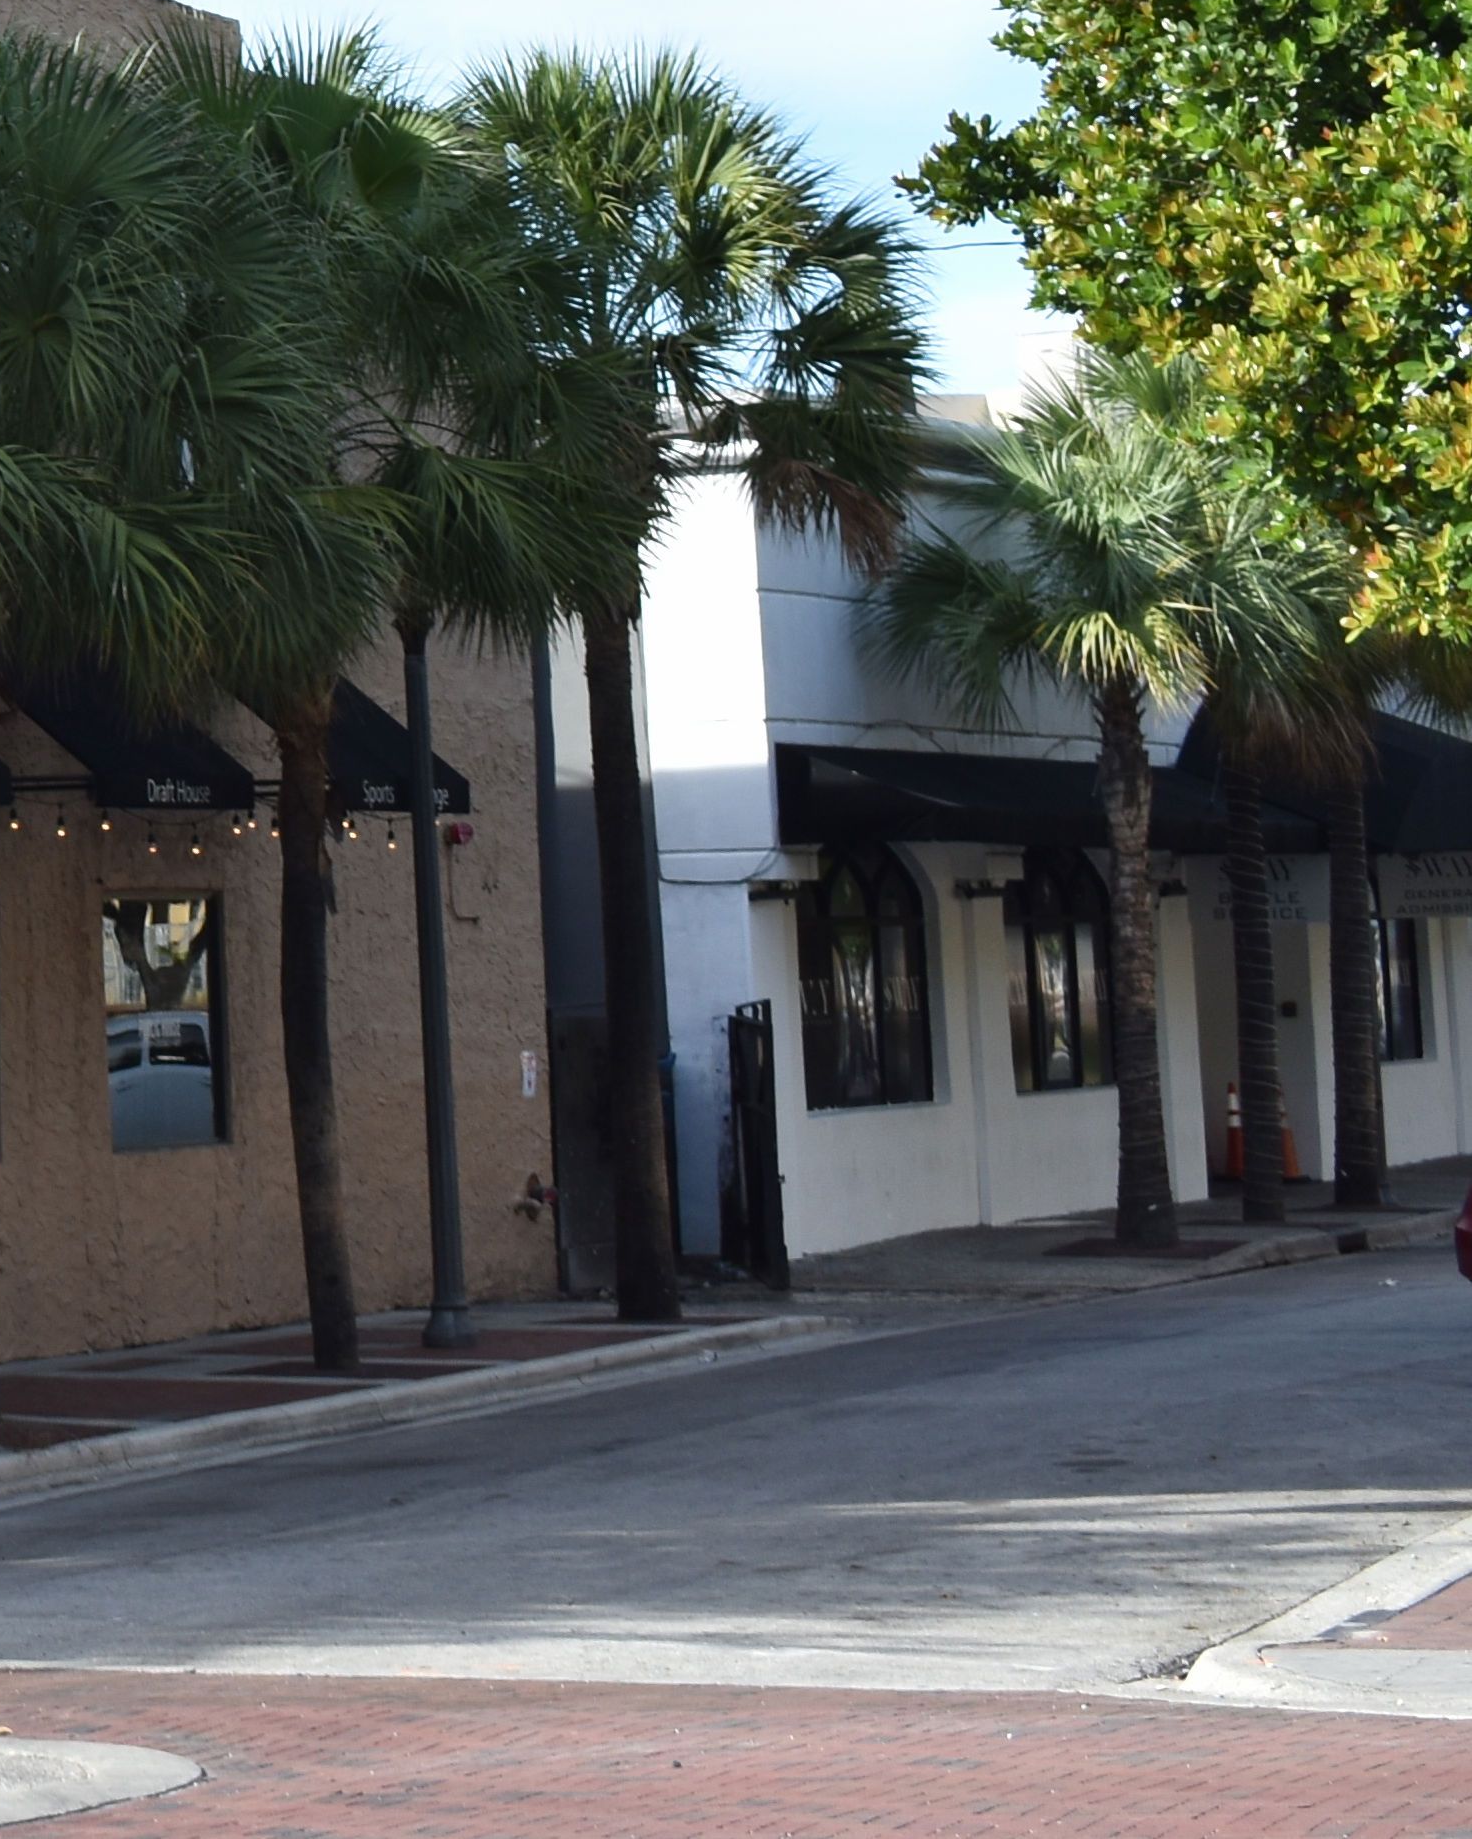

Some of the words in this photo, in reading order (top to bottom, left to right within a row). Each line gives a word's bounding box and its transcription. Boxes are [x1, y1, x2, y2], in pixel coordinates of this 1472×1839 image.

[146, 779, 175, 803] Draft
[176, 779, 211, 803] House
[362, 779, 395, 809] Sports
